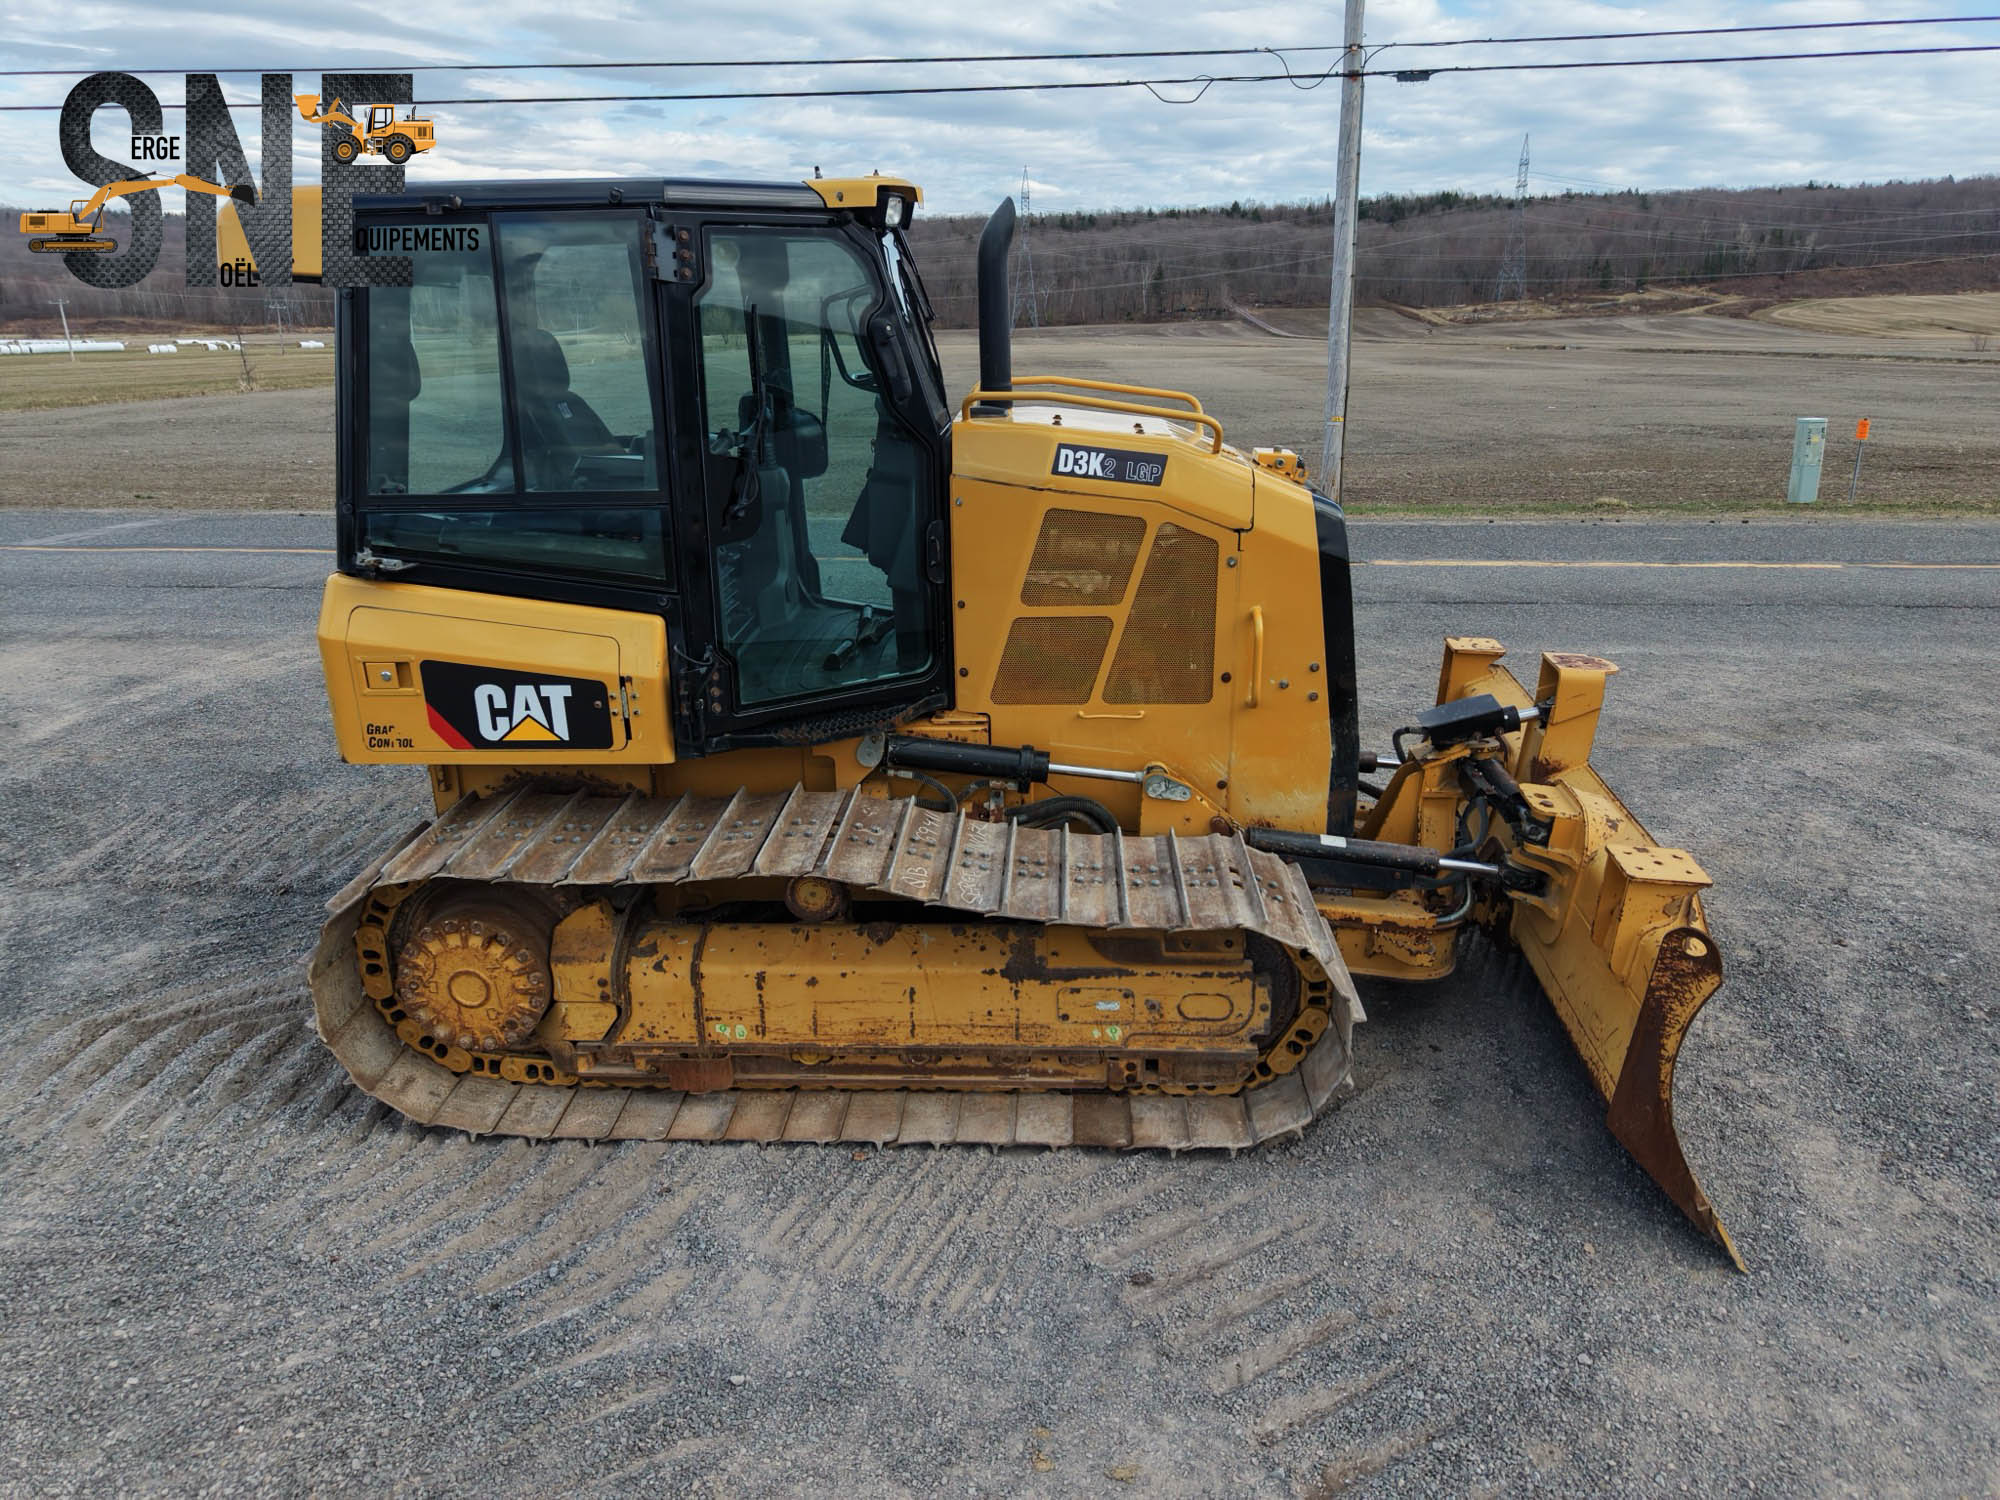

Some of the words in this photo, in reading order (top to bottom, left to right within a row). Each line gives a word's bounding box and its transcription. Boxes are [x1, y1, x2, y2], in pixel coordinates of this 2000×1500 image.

[1057, 447, 1117, 479] D3K2
[1125, 461, 1161, 482] LGP
[474, 684, 572, 741] CAT
